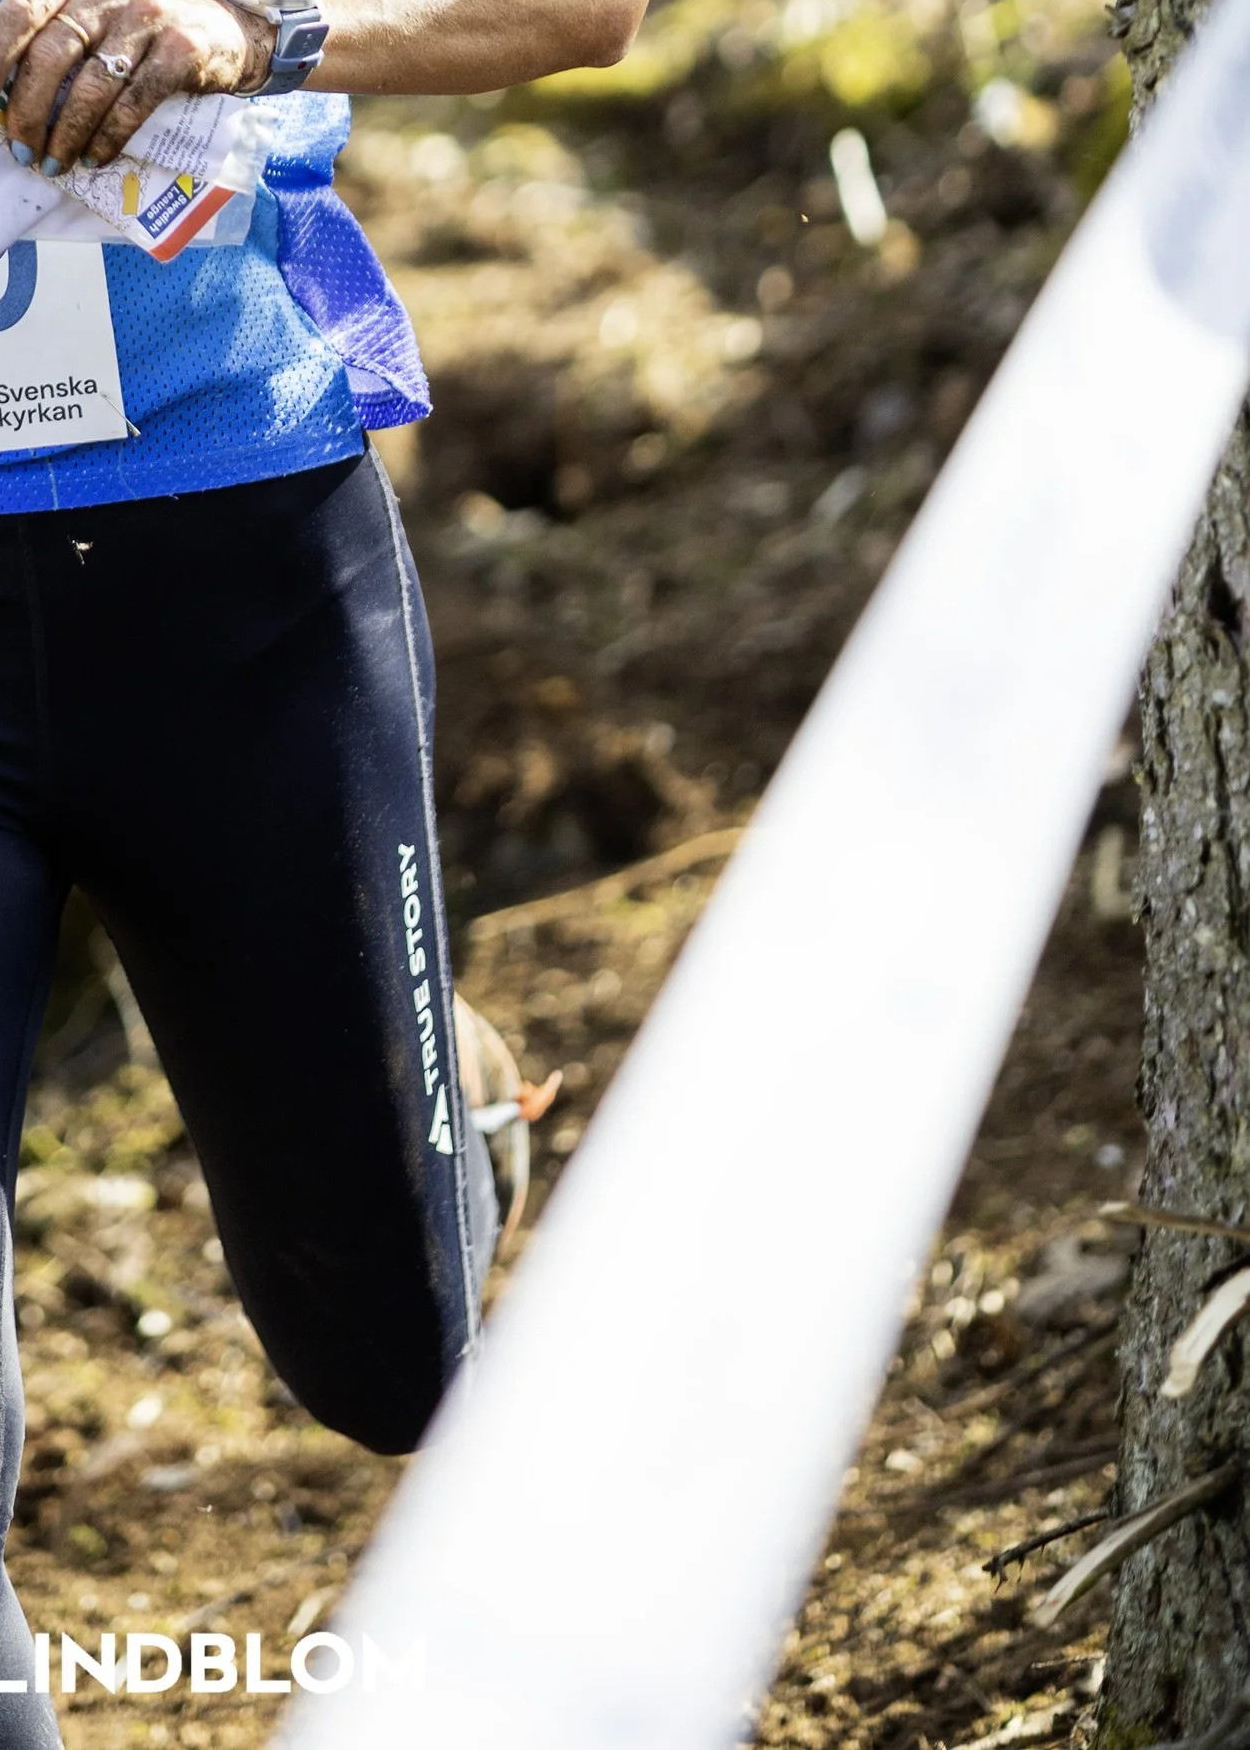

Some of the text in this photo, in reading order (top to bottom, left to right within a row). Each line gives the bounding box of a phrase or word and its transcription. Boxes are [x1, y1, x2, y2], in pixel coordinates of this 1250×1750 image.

[149, 194, 188, 233] Swedish
[398, 843, 439, 1096] TRUE STORY
